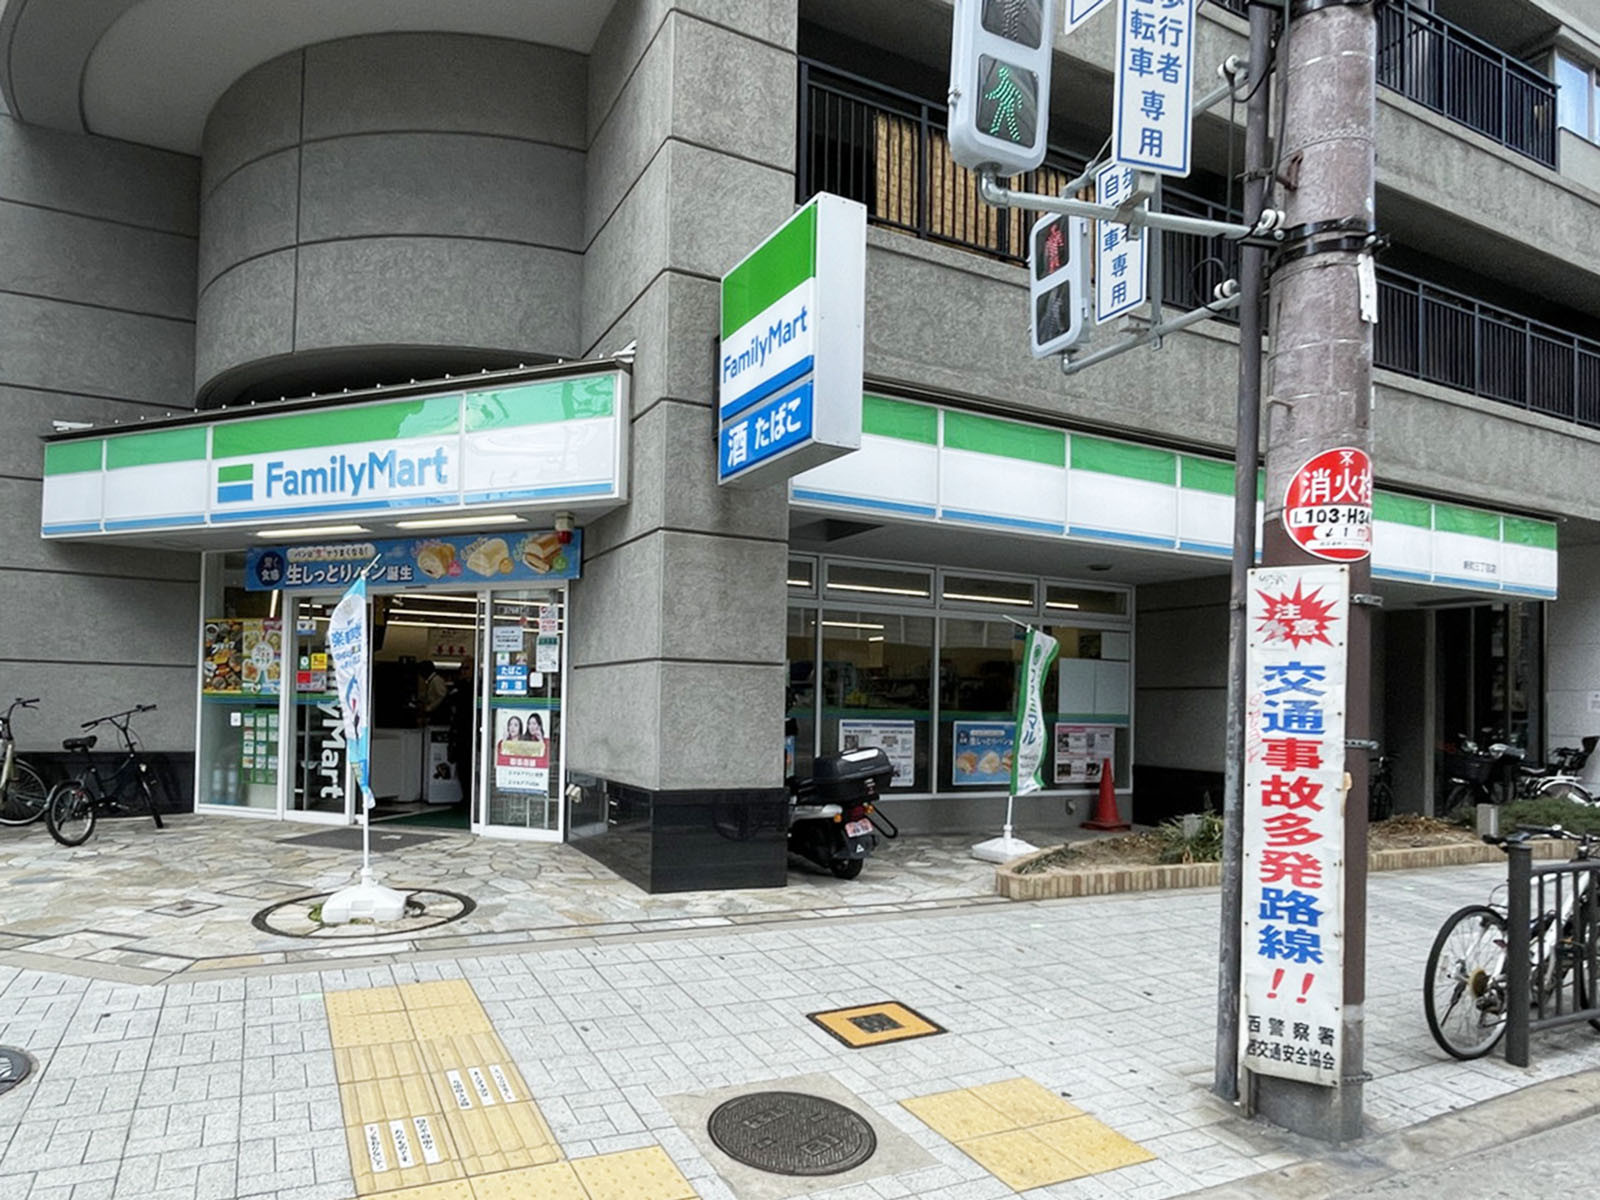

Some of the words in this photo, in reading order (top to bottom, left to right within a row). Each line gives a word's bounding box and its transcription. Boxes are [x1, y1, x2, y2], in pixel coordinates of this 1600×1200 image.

[1129, 0, 1156, 77] 転車
[1138, 90, 1165, 158] 専用
[1103, 174, 1120, 252] 自車
[1110, 252, 1128, 307] 専用
[723, 305, 808, 384] FamilyMart
[727, 420, 748, 468] 酒
[754, 396, 802, 451] たばこ
[265, 447, 449, 498] FamilyMart
